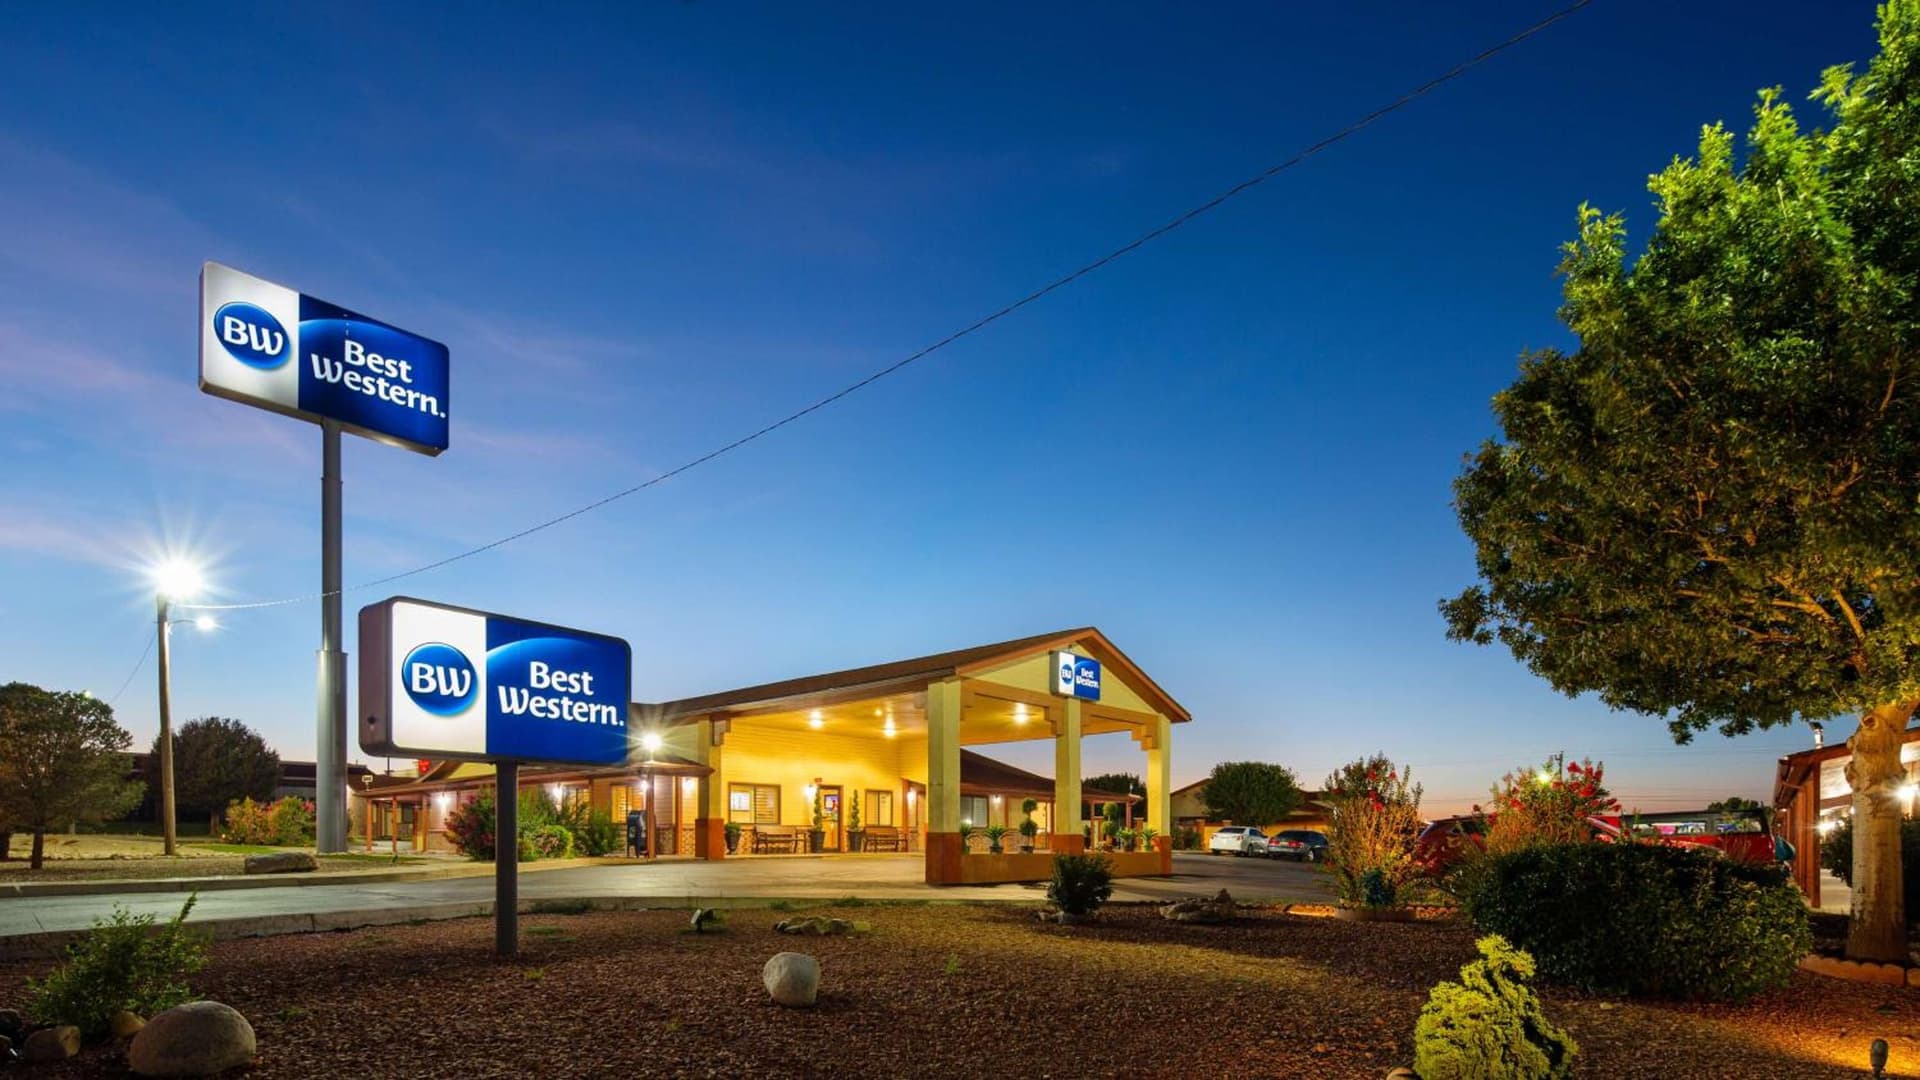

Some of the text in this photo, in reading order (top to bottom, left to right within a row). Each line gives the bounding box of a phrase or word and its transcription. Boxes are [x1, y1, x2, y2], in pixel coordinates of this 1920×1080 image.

[223, 316, 283, 355] BW
[344, 339, 412, 383] Best
[411, 662, 471, 697] BW
[530, 661, 594, 696] Best
